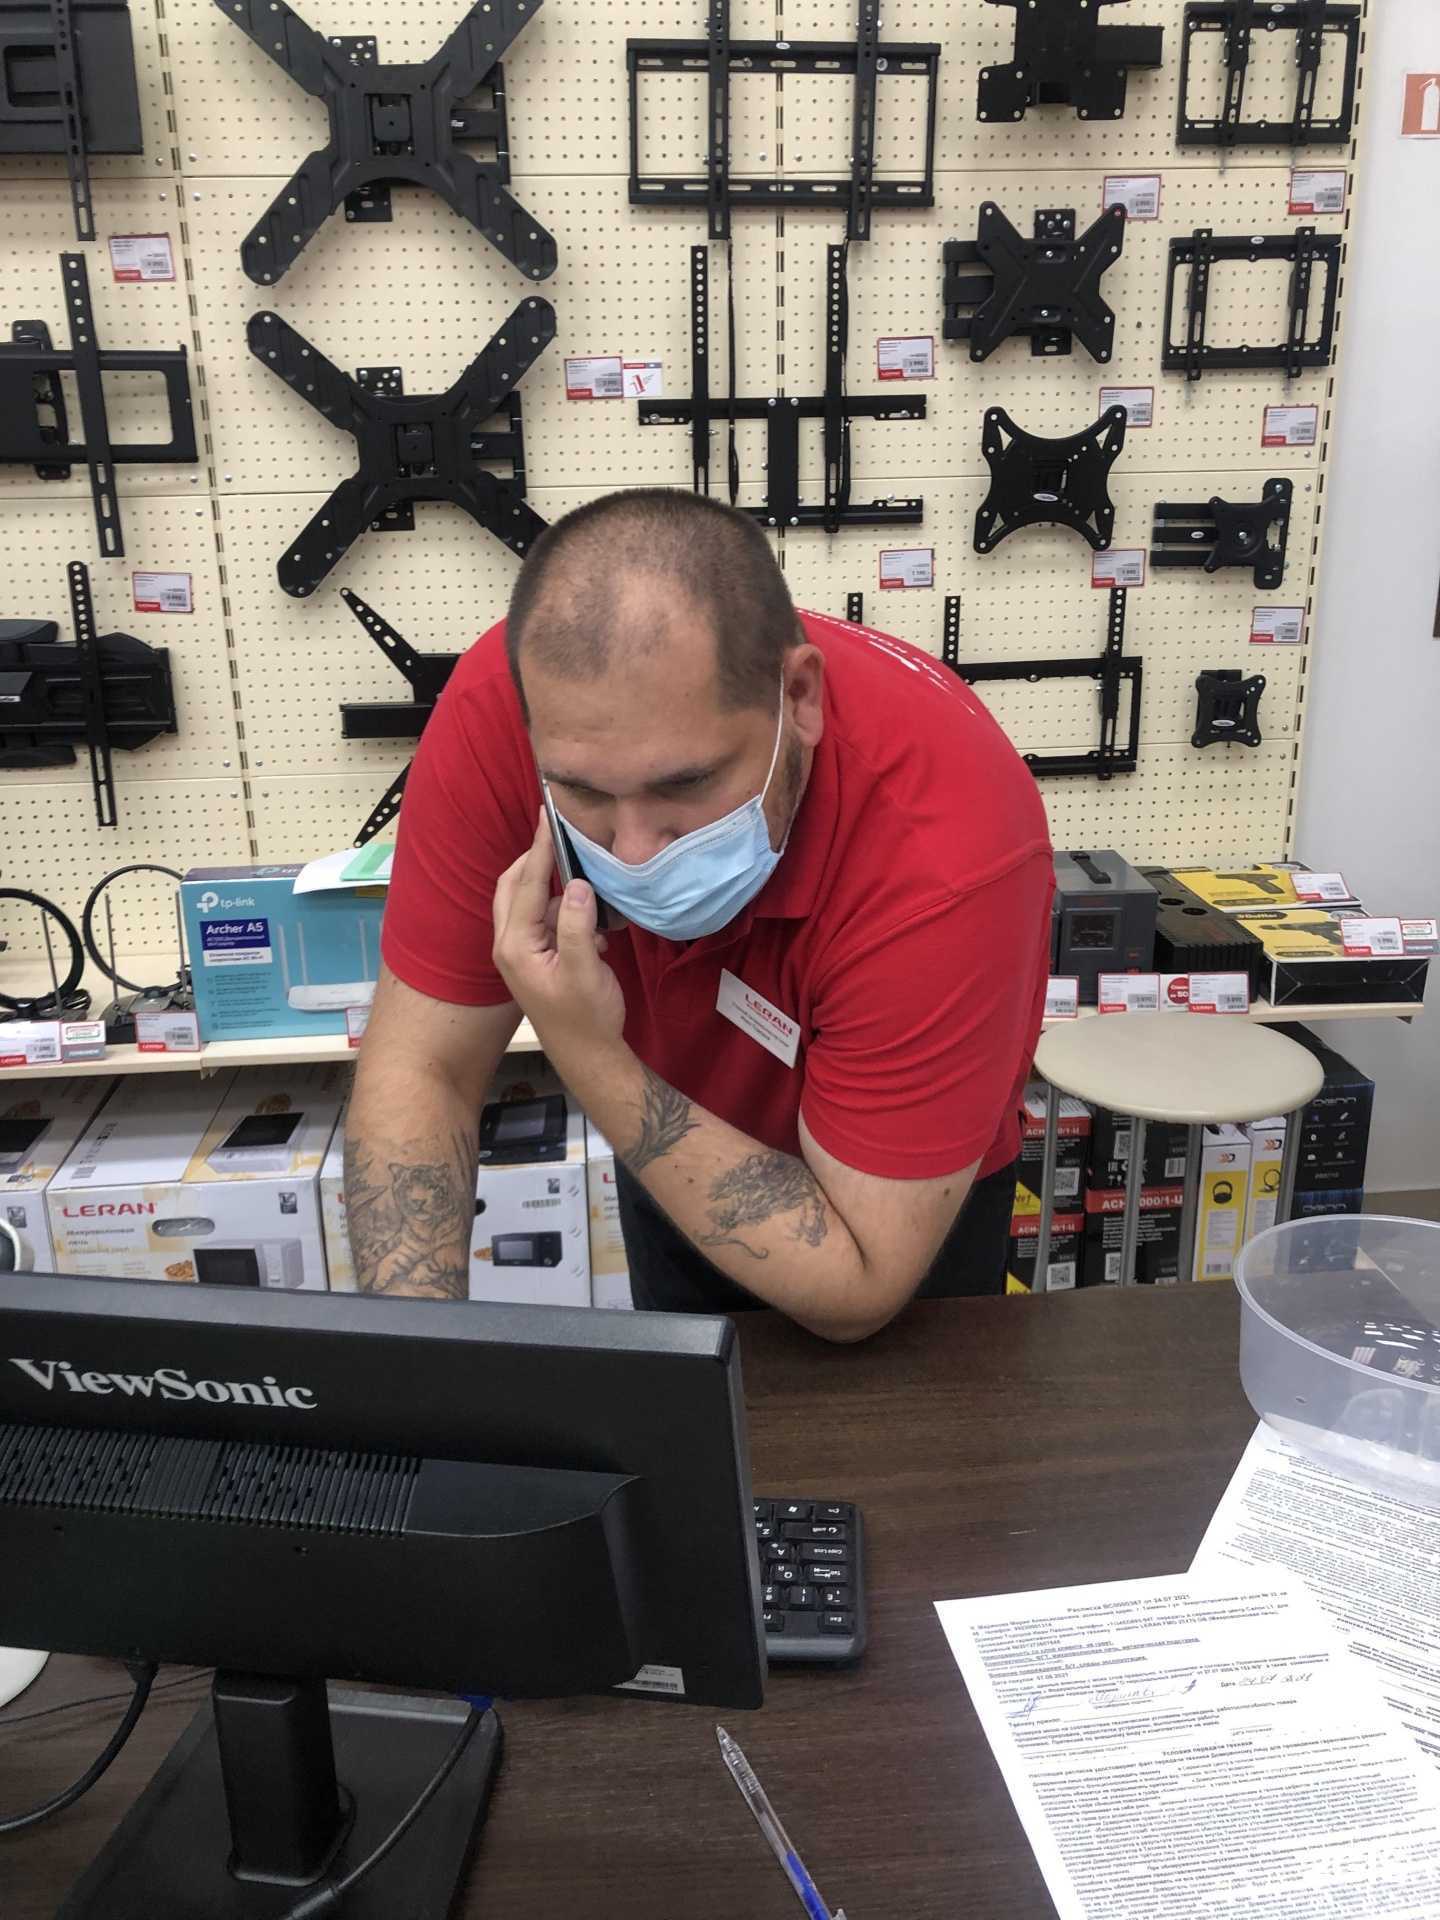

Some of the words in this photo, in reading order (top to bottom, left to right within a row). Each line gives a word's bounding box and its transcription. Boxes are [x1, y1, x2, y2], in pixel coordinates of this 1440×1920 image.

[220, 897, 255, 908] tp-link
[206, 924, 244, 934] Archer
[745, 993, 793, 1035] LERAN
[63, 1202, 154, 1217] LERAN
[8, 1358, 318, 1409] ViewSonic
